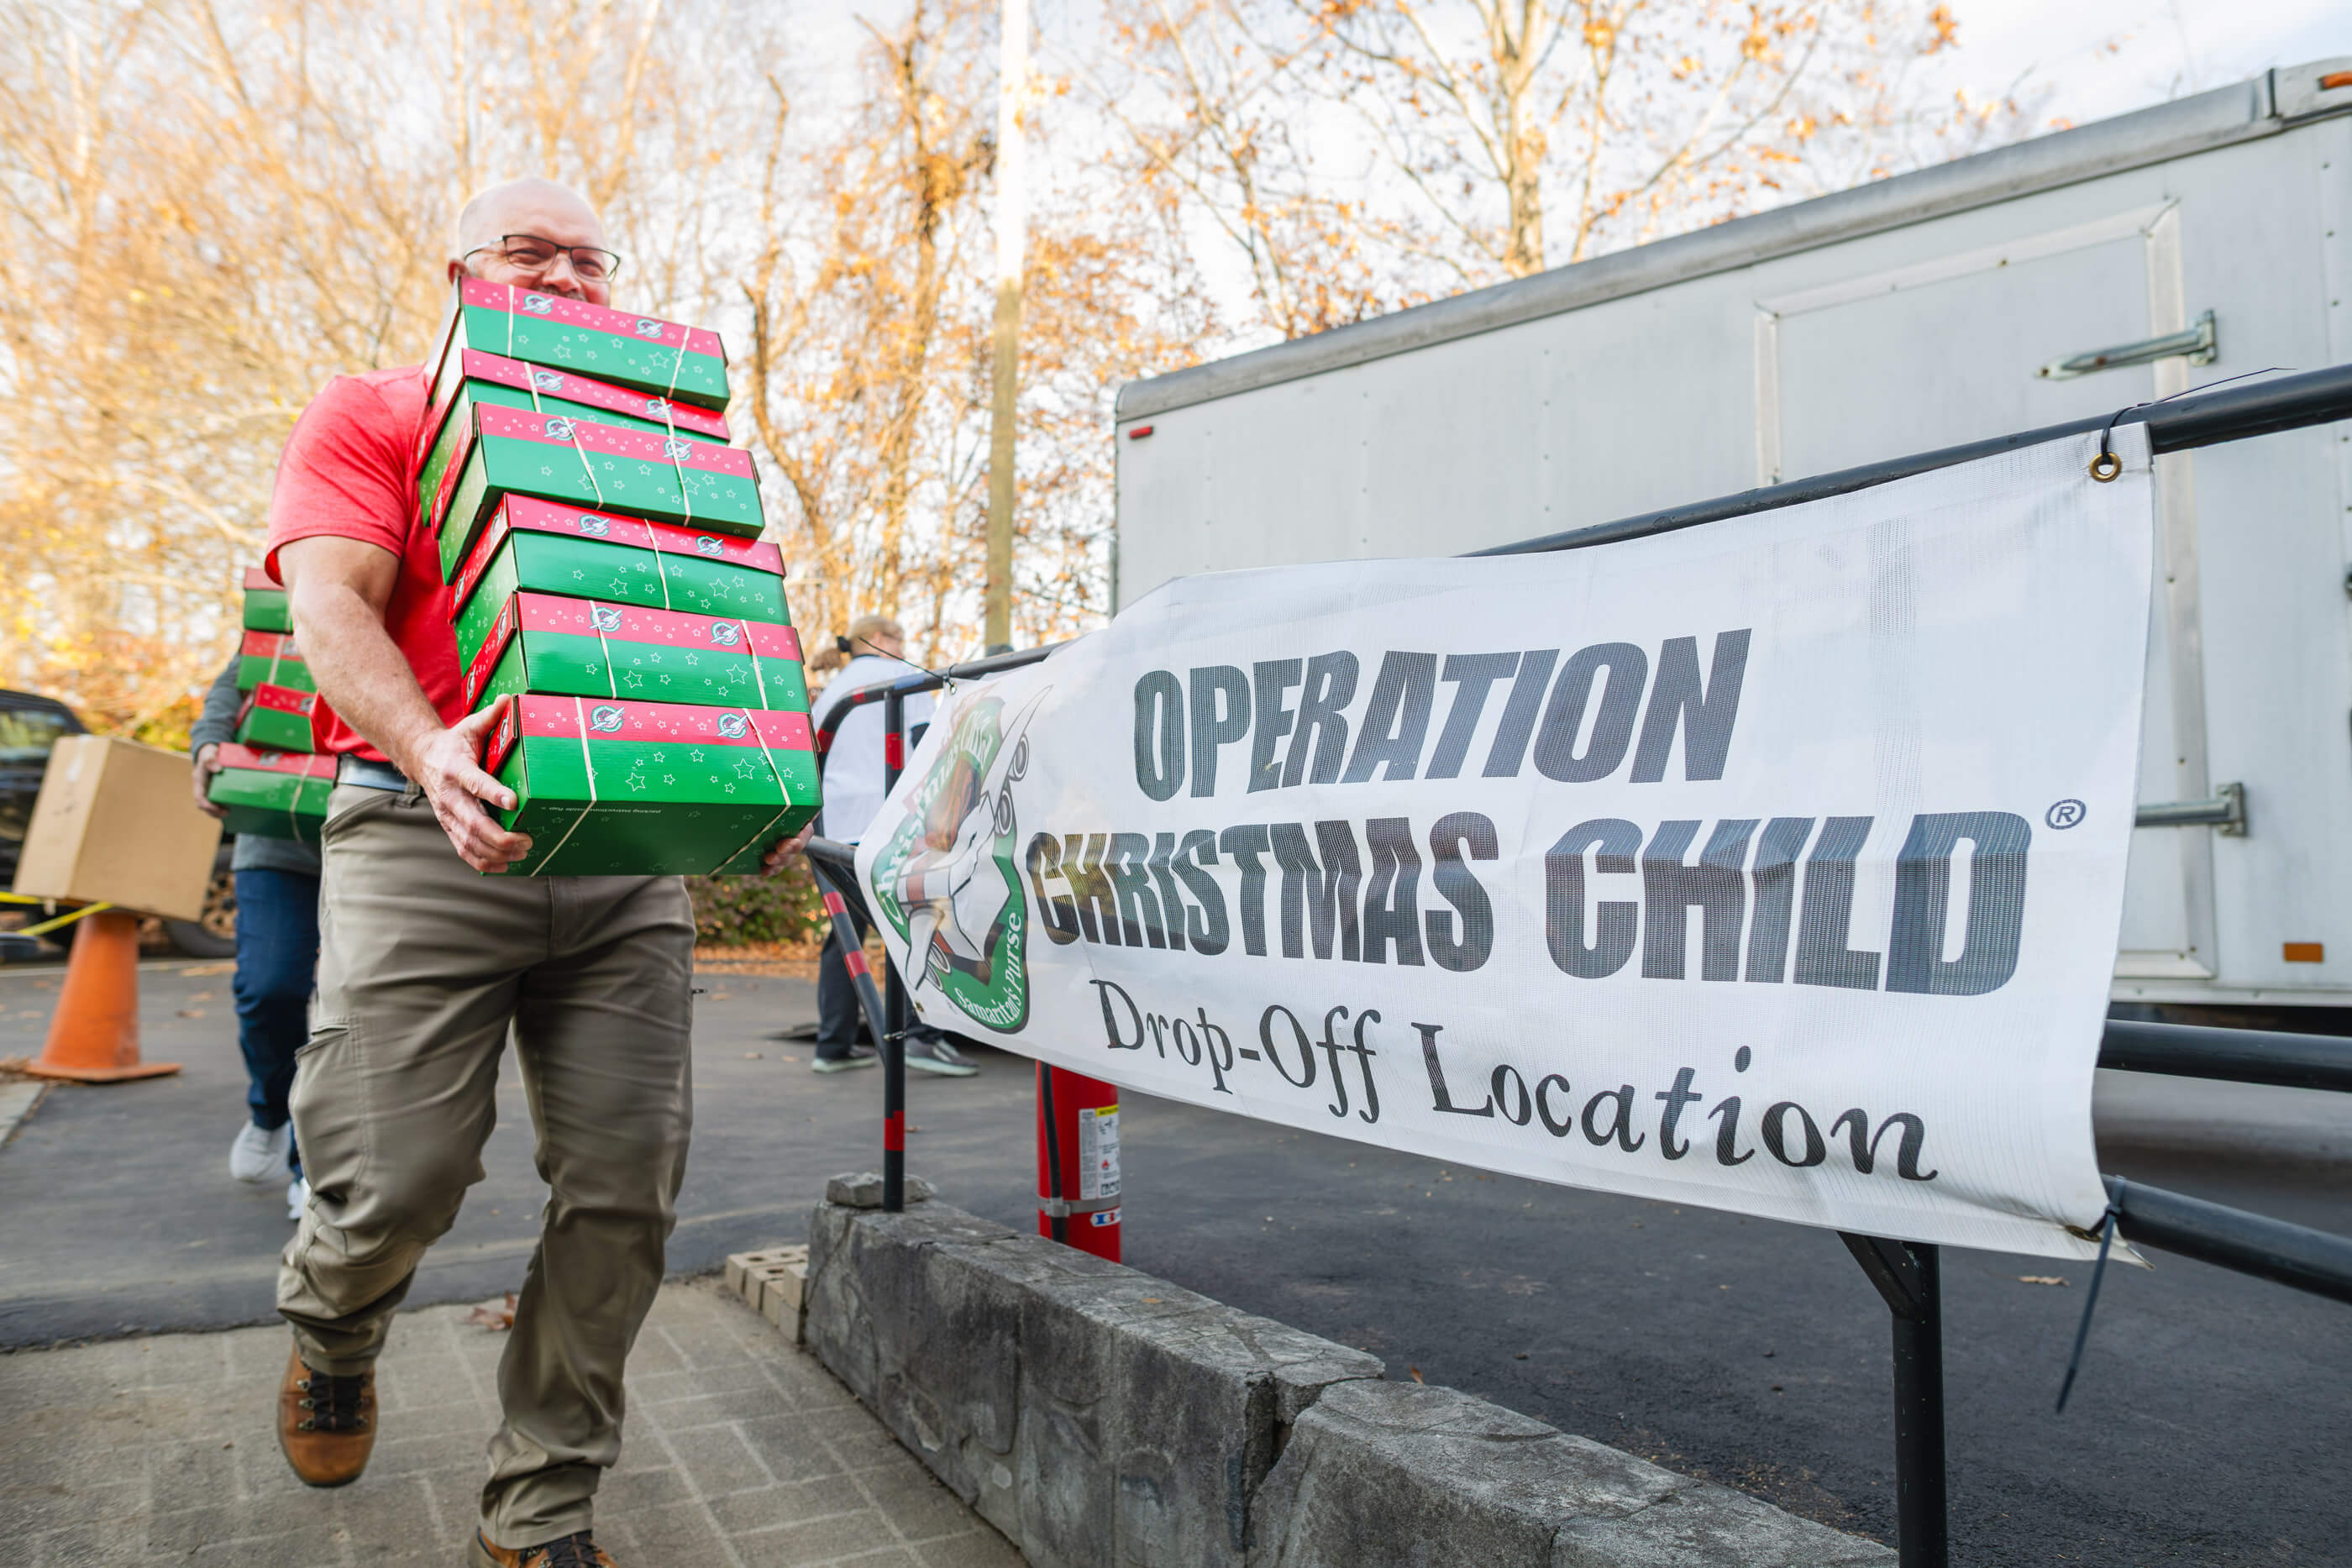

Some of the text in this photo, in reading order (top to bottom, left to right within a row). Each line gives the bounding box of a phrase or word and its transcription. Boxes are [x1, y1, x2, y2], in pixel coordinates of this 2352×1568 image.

[1134, 628, 1751, 801] OPERATION
[1005, 912, 1021, 995] Purse
[1026, 811, 2032, 996] CHRISTMAS CHILD
[1089, 978, 1939, 1183] Drop-Off Location
